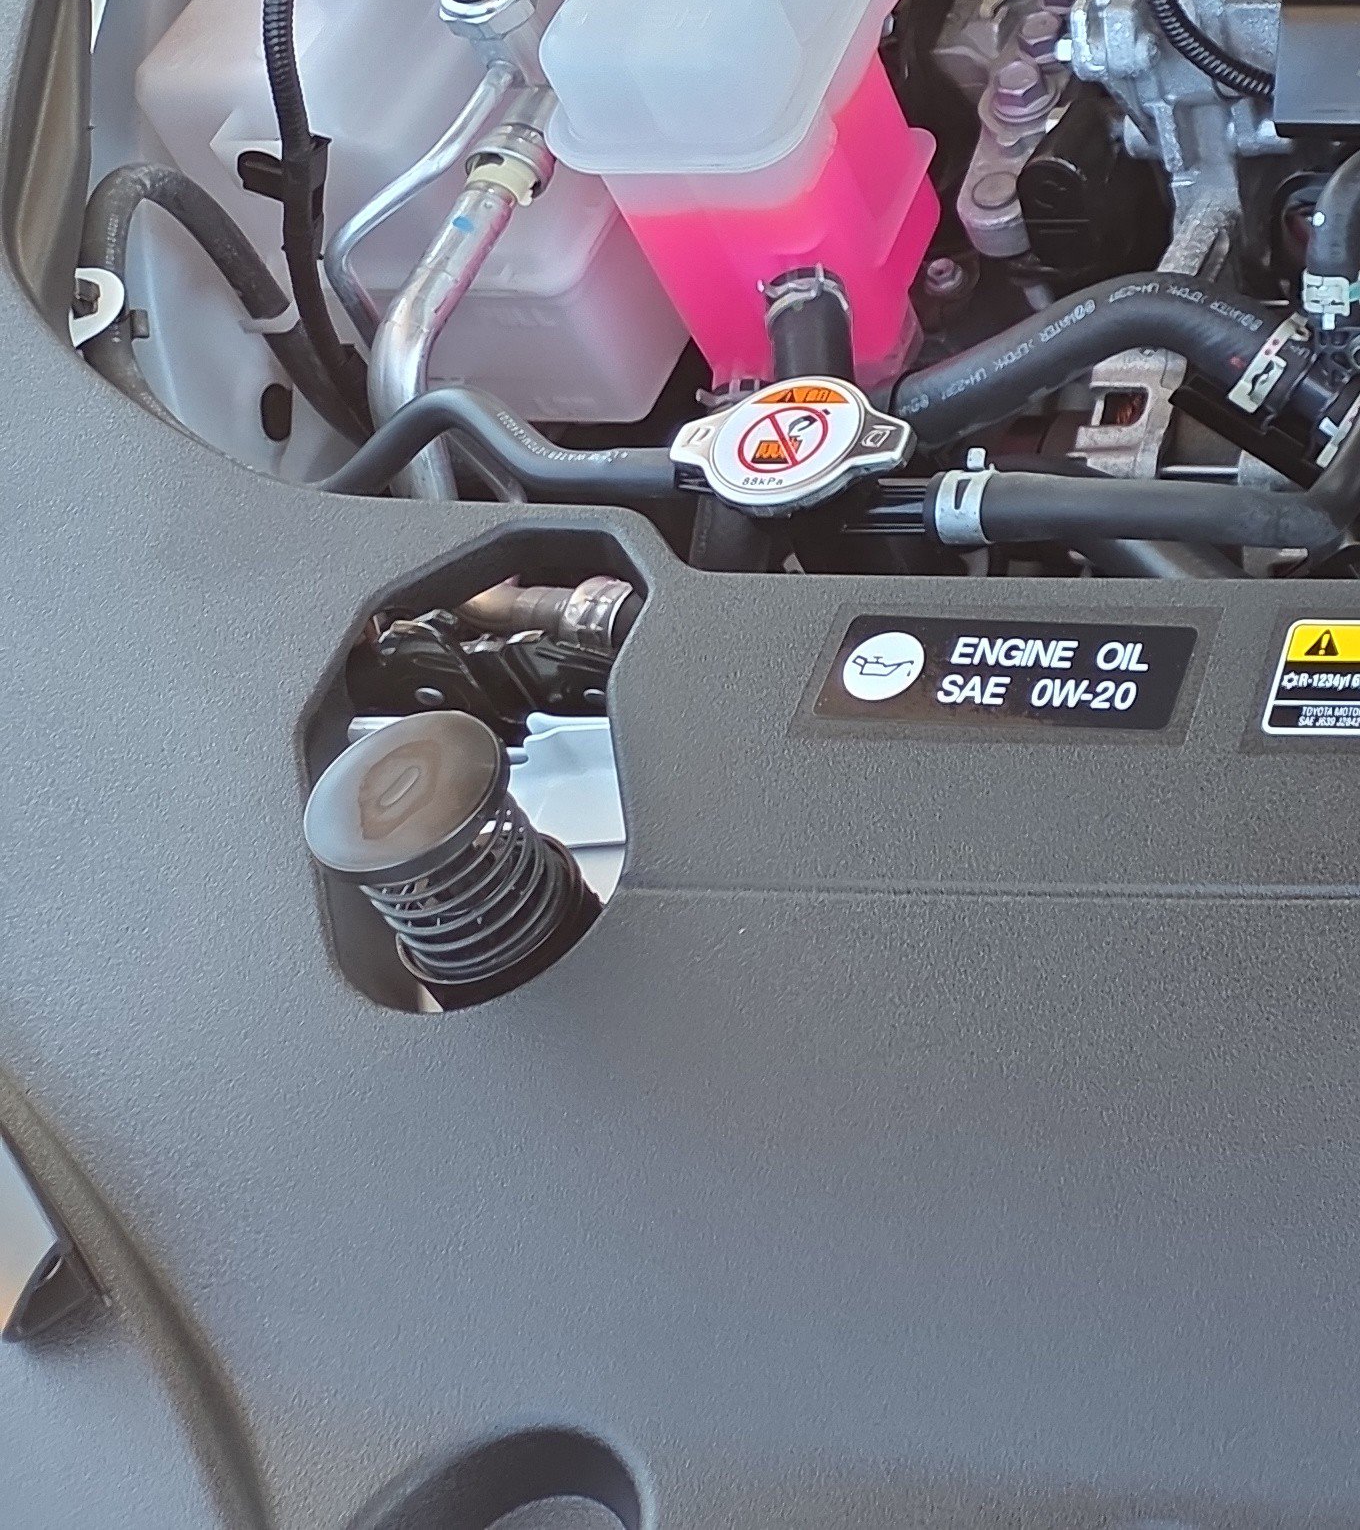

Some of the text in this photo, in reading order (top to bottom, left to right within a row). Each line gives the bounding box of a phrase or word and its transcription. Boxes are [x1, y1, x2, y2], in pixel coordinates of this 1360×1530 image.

[742, 477, 784, 486] 88kPa
[950, 636, 1150, 672] ENGINE OIL
[936, 675, 1138, 711] SAE 0W-20
[1302, 706, 1334, 717] TOYOTA
[1298, 716, 1315, 726] SAE
